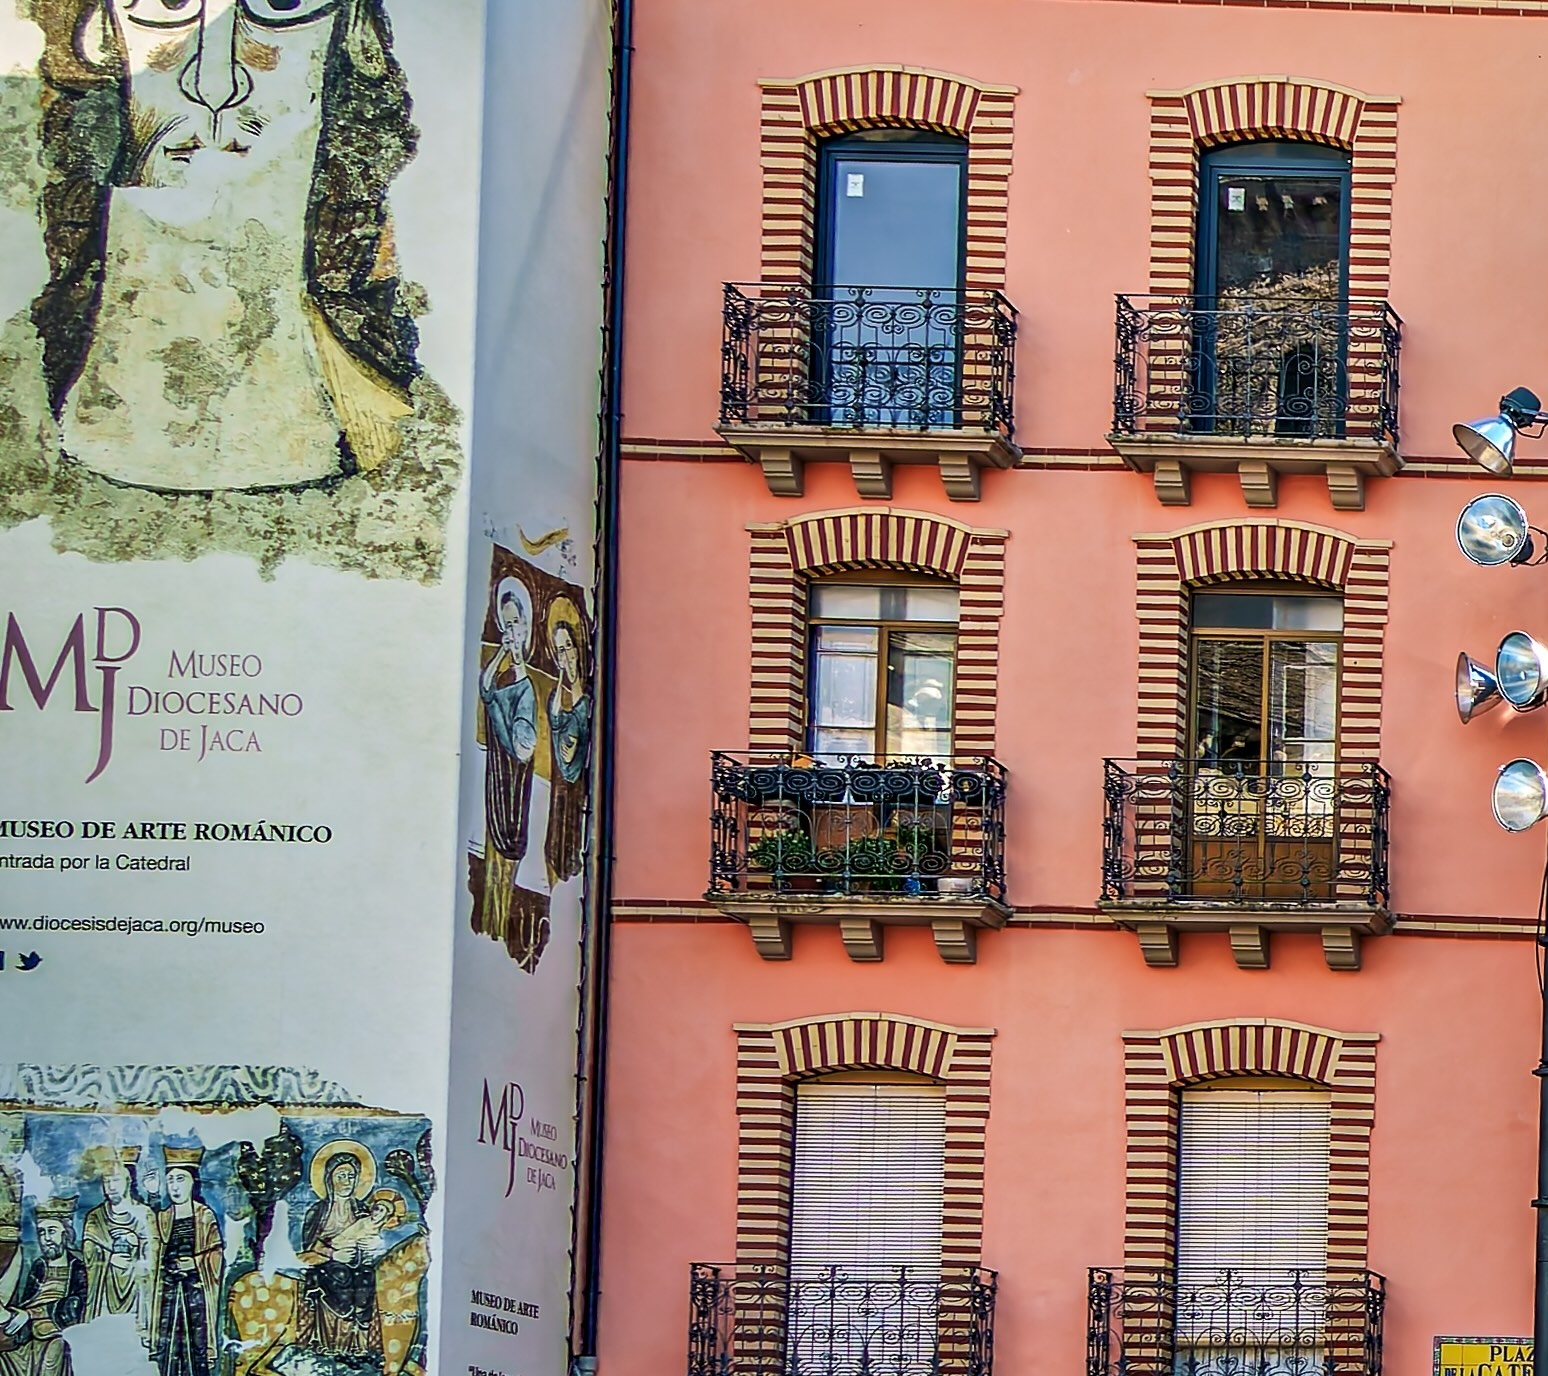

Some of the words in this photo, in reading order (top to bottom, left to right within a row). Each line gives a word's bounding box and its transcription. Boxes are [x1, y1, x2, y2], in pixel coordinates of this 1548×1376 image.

[168, 649, 262, 679] MUSEO
[126, 685, 304, 716] DIOCESANO
[197, 725, 262, 763] JACA
[81, 821, 117, 840] DE
[121, 822, 187, 841] ARTE
[193, 819, 332, 843] ROMÁNICO
[60, 856, 90, 873] por
[95, 855, 110, 869] la
[115, 854, 190, 871] Catedral
[471, 1289, 502, 1311] MUSEO
[504, 1297, 516, 1313] DE
[517, 1301, 540, 1319] ARTE
[470, 1312, 518, 1336] ROMÁNICO
[1490, 1345, 1534, 1361] PLAZ
